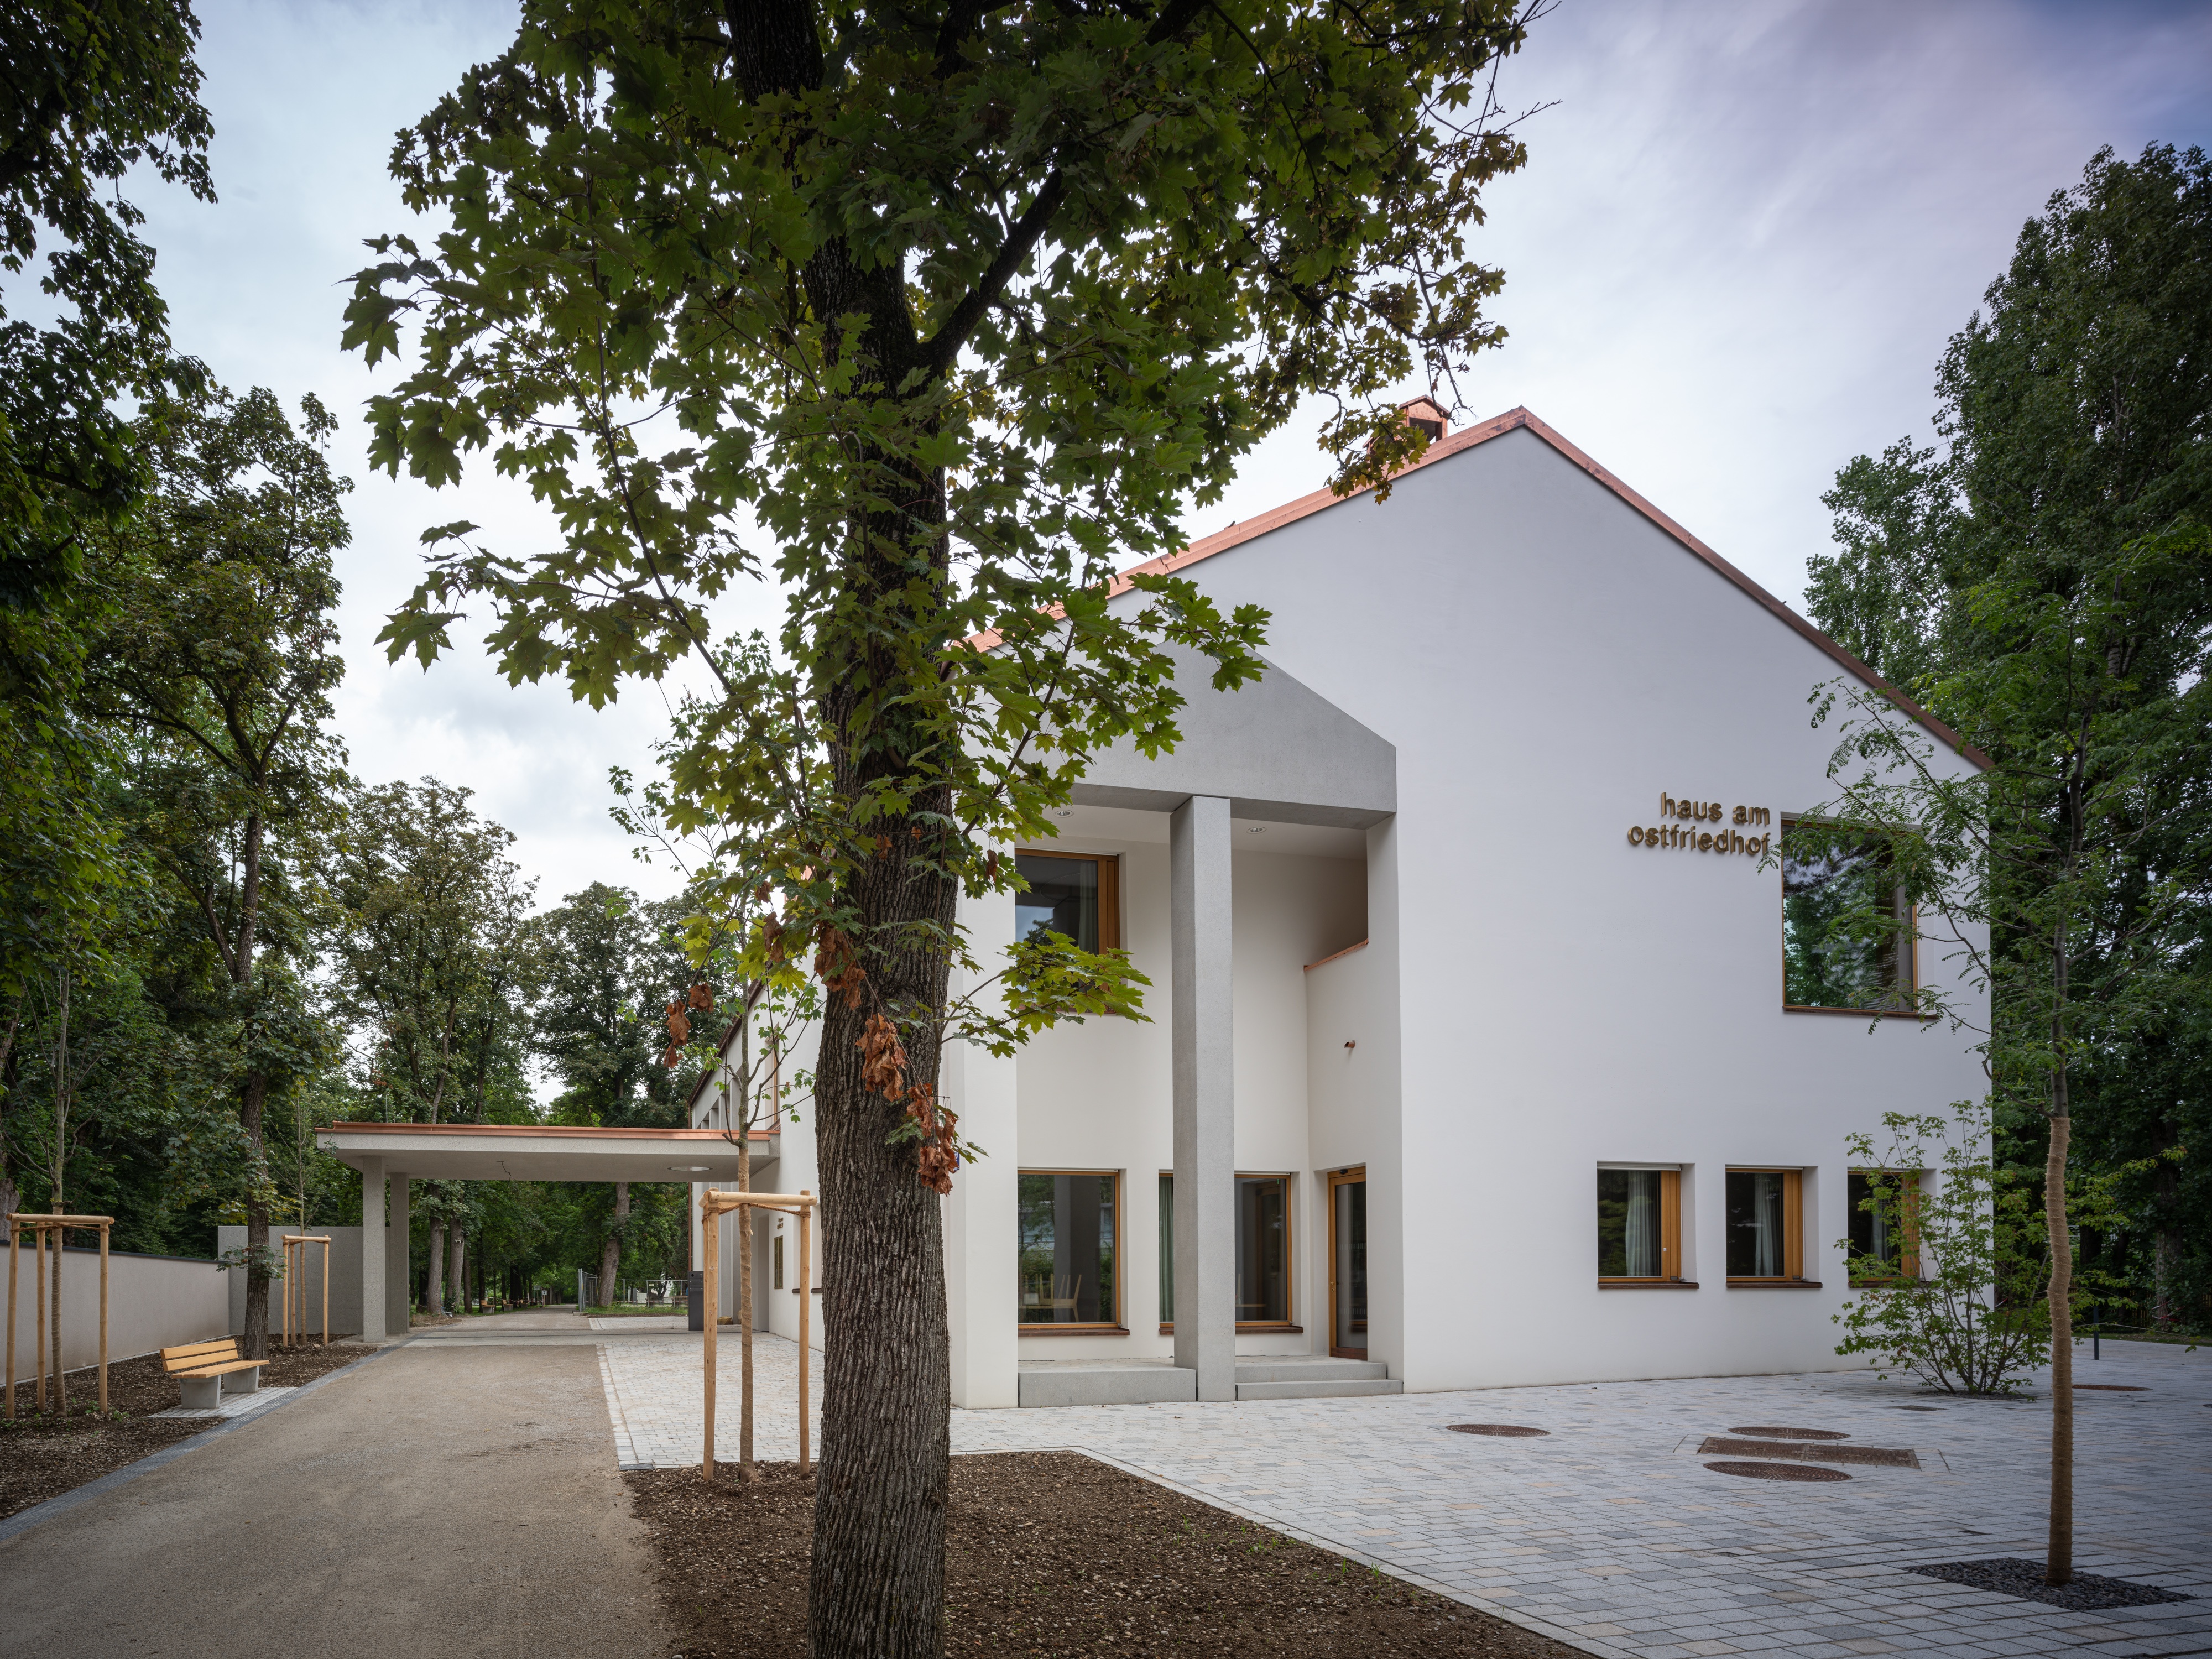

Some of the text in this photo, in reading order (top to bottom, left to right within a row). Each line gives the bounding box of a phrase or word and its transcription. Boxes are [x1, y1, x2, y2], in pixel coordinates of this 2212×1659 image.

[1661, 792, 1770, 825] haus am
[1627, 824, 1771, 855] ostfriedhof
